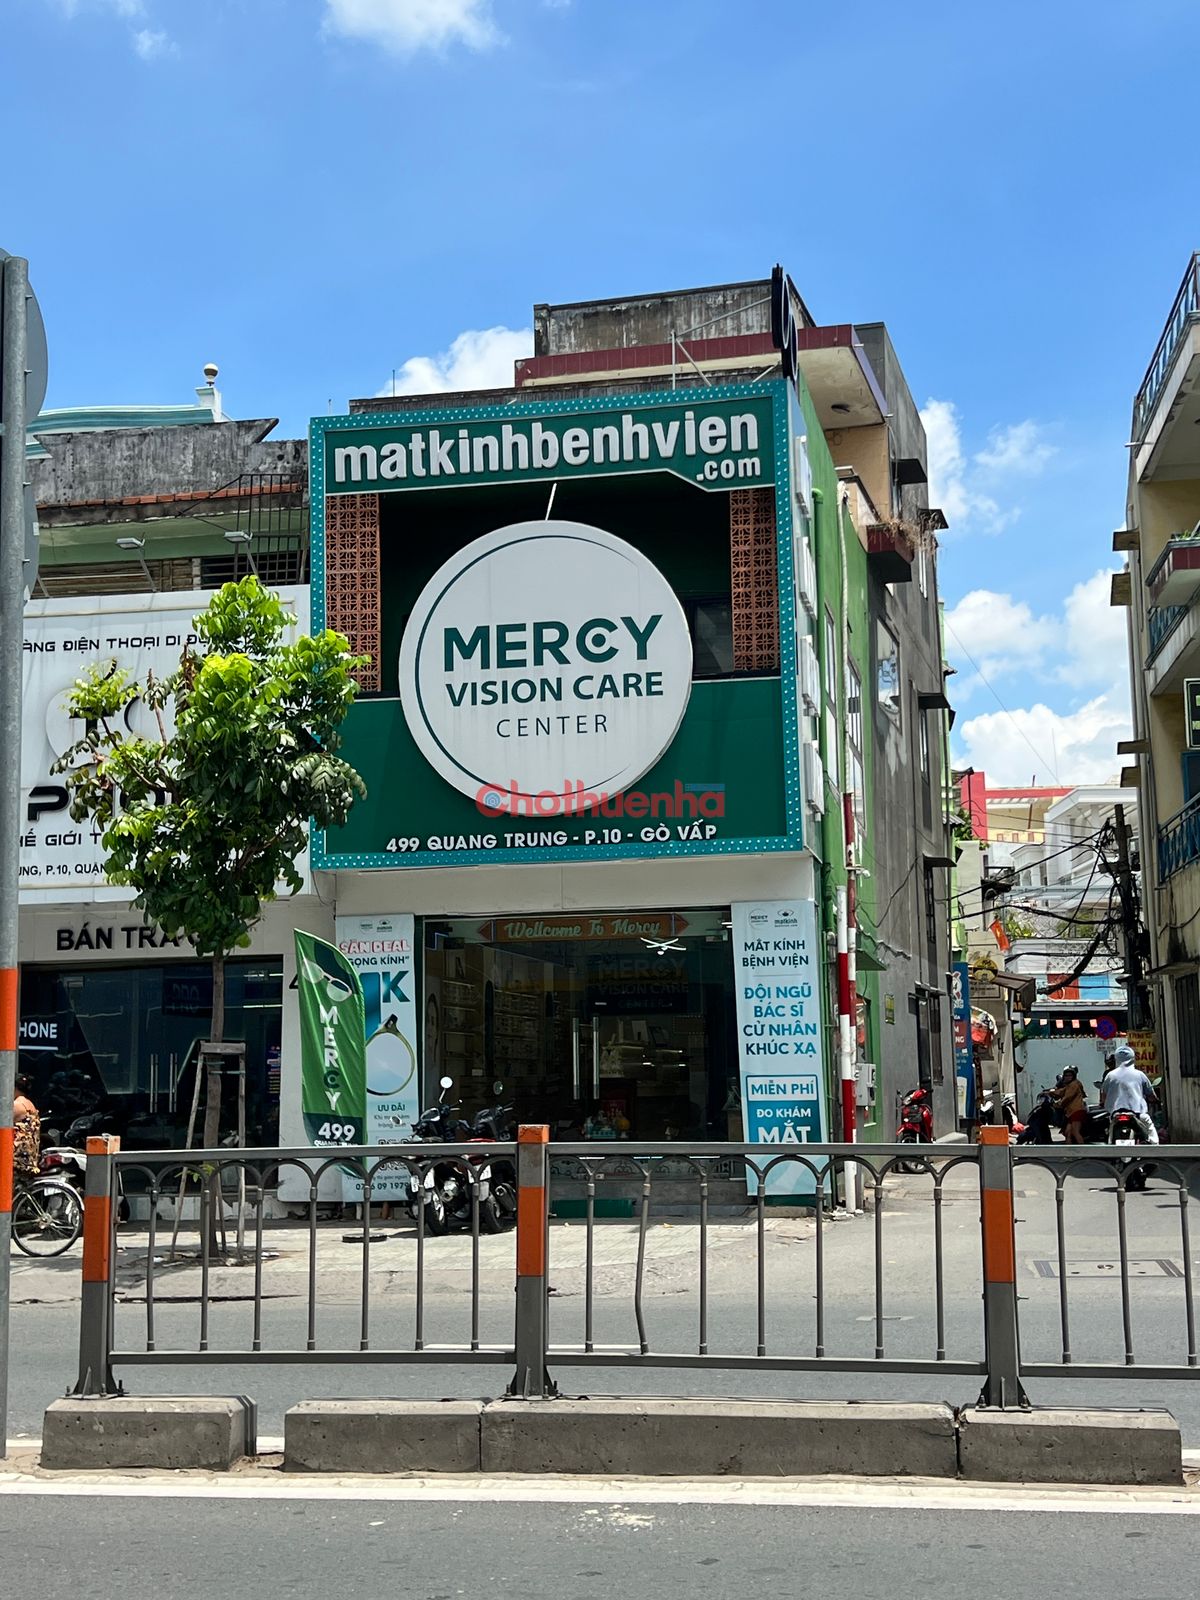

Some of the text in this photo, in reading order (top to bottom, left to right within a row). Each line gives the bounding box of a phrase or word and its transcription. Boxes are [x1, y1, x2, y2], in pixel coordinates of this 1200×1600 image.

[334, 411, 760, 483] matkinhbenhvien
[696, 456, 761, 481] .com
[63, 637, 100, 654] ĐIỆN
[106, 636, 160, 650] THOẠI
[165, 635, 181, 646] DI
[444, 614, 664, 672] MERCY
[445, 671, 664, 707] VISION CARE
[496, 714, 608, 738] CENTER
[45, 831, 82, 846] GIỚI
[386, 837, 420, 853] 499
[426, 834, 498, 851] QUANG
[504, 830, 568, 848] TRUNG
[584, 828, 622, 845] P.10
[640, 822, 671, 842] GÒ
[677, 818, 717, 840] VẤP
[46, 864, 72, 876] P.10,
[56, 922, 113, 951] BÁN
[504, 918, 660, 939] Wellcome To Mercy
[372, 940, 410, 953] DEAL
[773, 937, 805, 951] KÍNH
[742, 952, 809, 970] BỆNH VIỆN
[744, 982, 811, 1002] ĐỘI NGŨ
[754, 1001, 804, 1017] BÁC SĨ
[769, 1019, 817, 1036] NHÂN
[320, 1005, 341, 1111] MERCY
[746, 1039, 817, 1058] KHÚC XẠ
[791, 1080, 814, 1094] PHÍ
[756, 1105, 811, 1118] ĐO KHÁM
[318, 1122, 355, 1142] 499
[757, 1119, 811, 1143] MẮT
